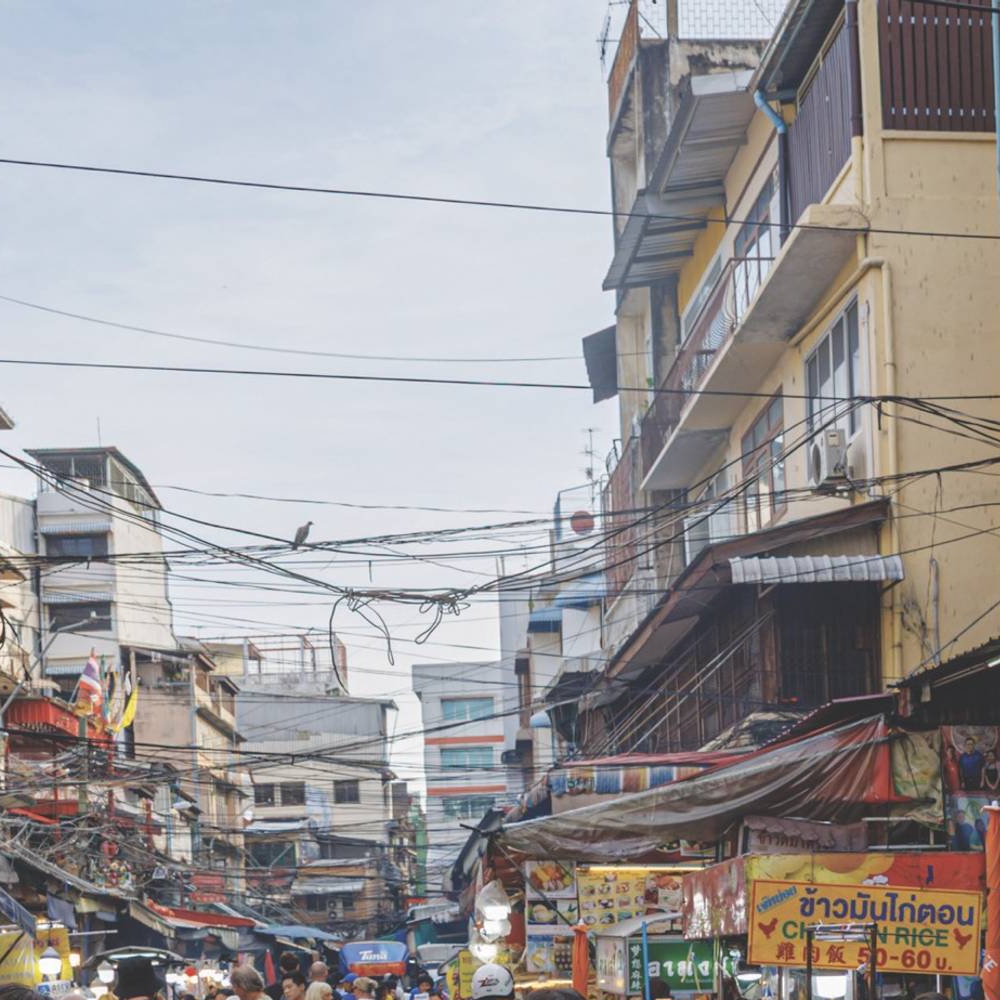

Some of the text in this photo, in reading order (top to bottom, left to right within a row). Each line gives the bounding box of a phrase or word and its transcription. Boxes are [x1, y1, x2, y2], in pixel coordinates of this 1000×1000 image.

[799, 887, 975, 927] ข้าวมันไก่ตอน
[894, 927, 950, 948] RICE
